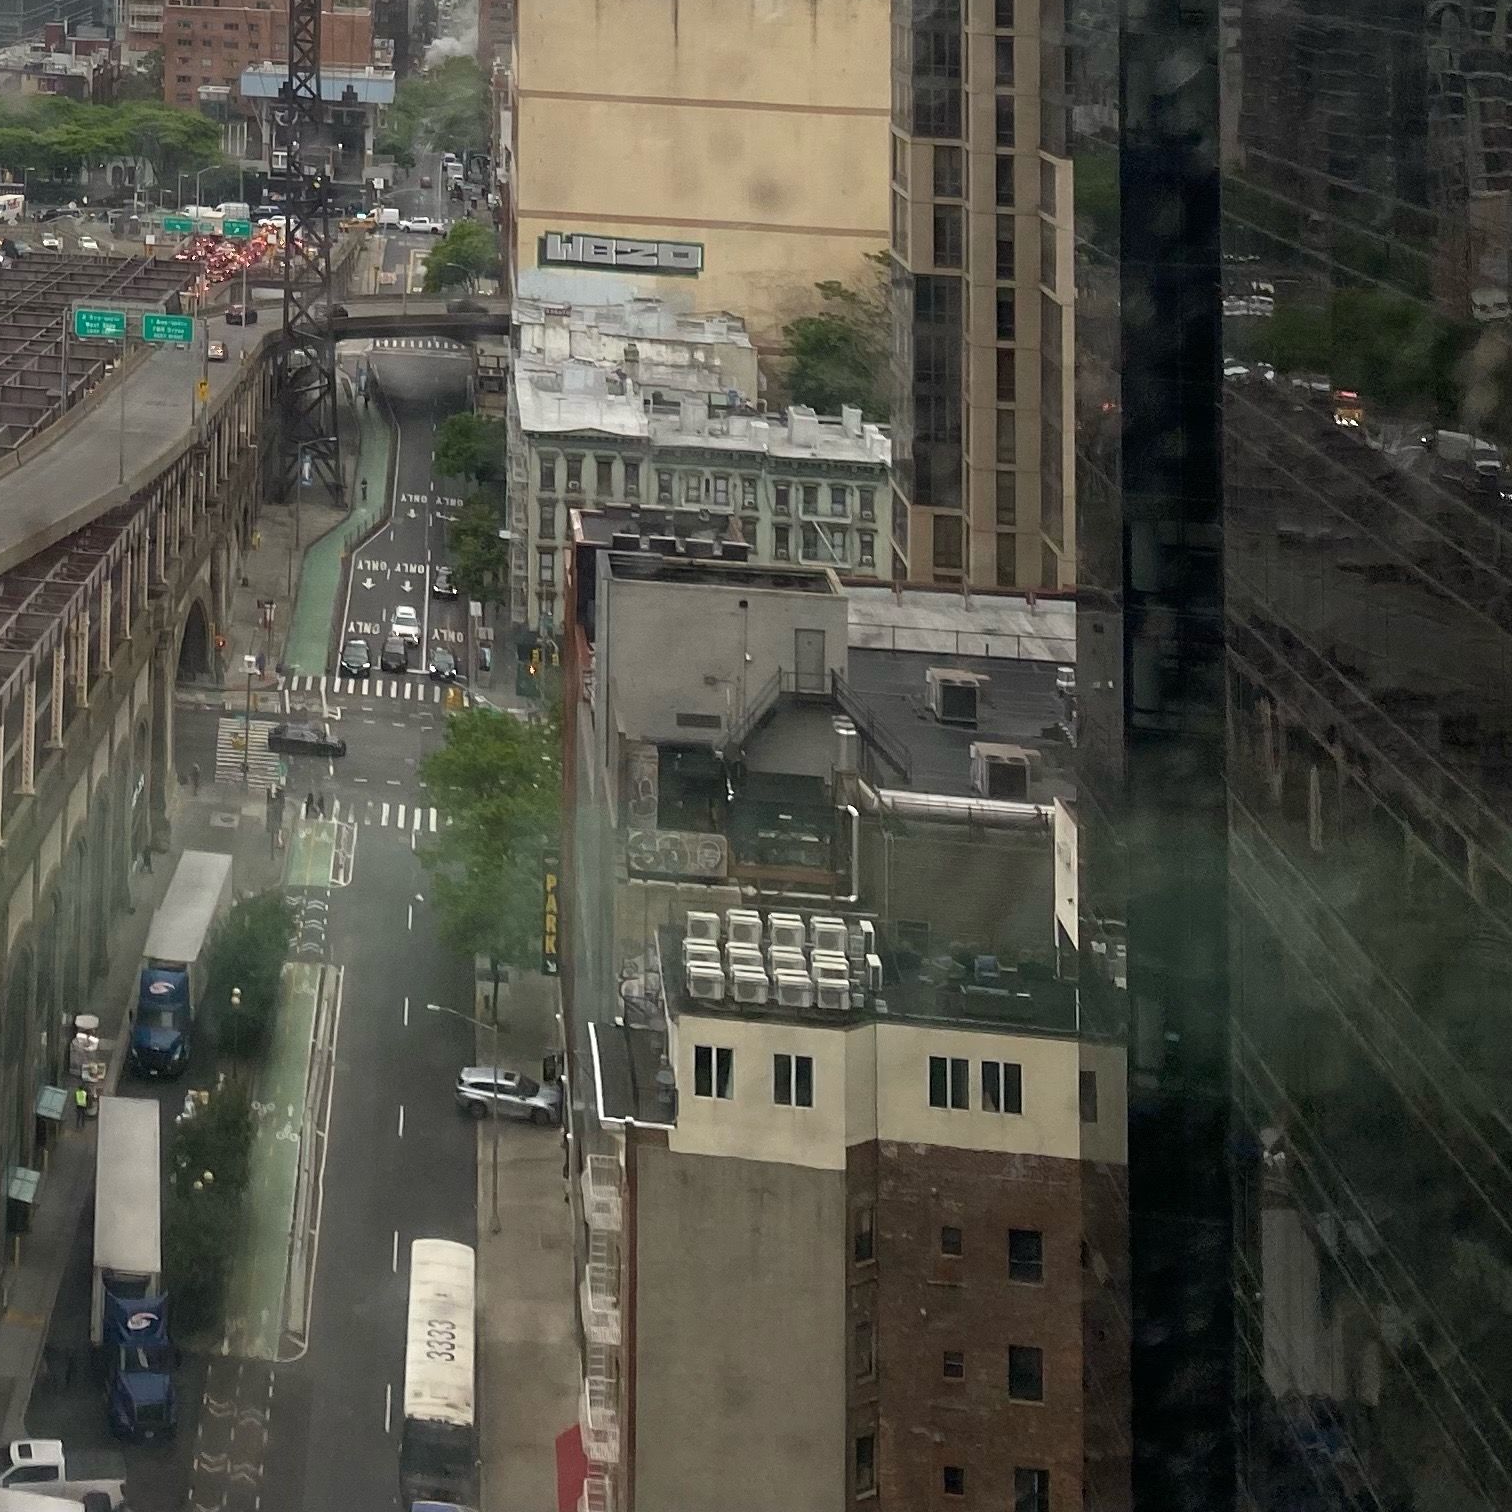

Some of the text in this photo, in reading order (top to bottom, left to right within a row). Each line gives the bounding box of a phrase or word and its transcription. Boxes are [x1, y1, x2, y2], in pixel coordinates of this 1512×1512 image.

[401, 493, 428, 504] ONLY
[436, 496, 464, 507] ONLY
[356, 559, 388, 571] ONLY
[394, 562, 425, 574] ONLY
[348, 621, 381, 635] ONLY
[431, 628, 464, 643] ONLY
[545, 872, 558, 954] PARK
[426, 1319, 456, 1362] 3333
